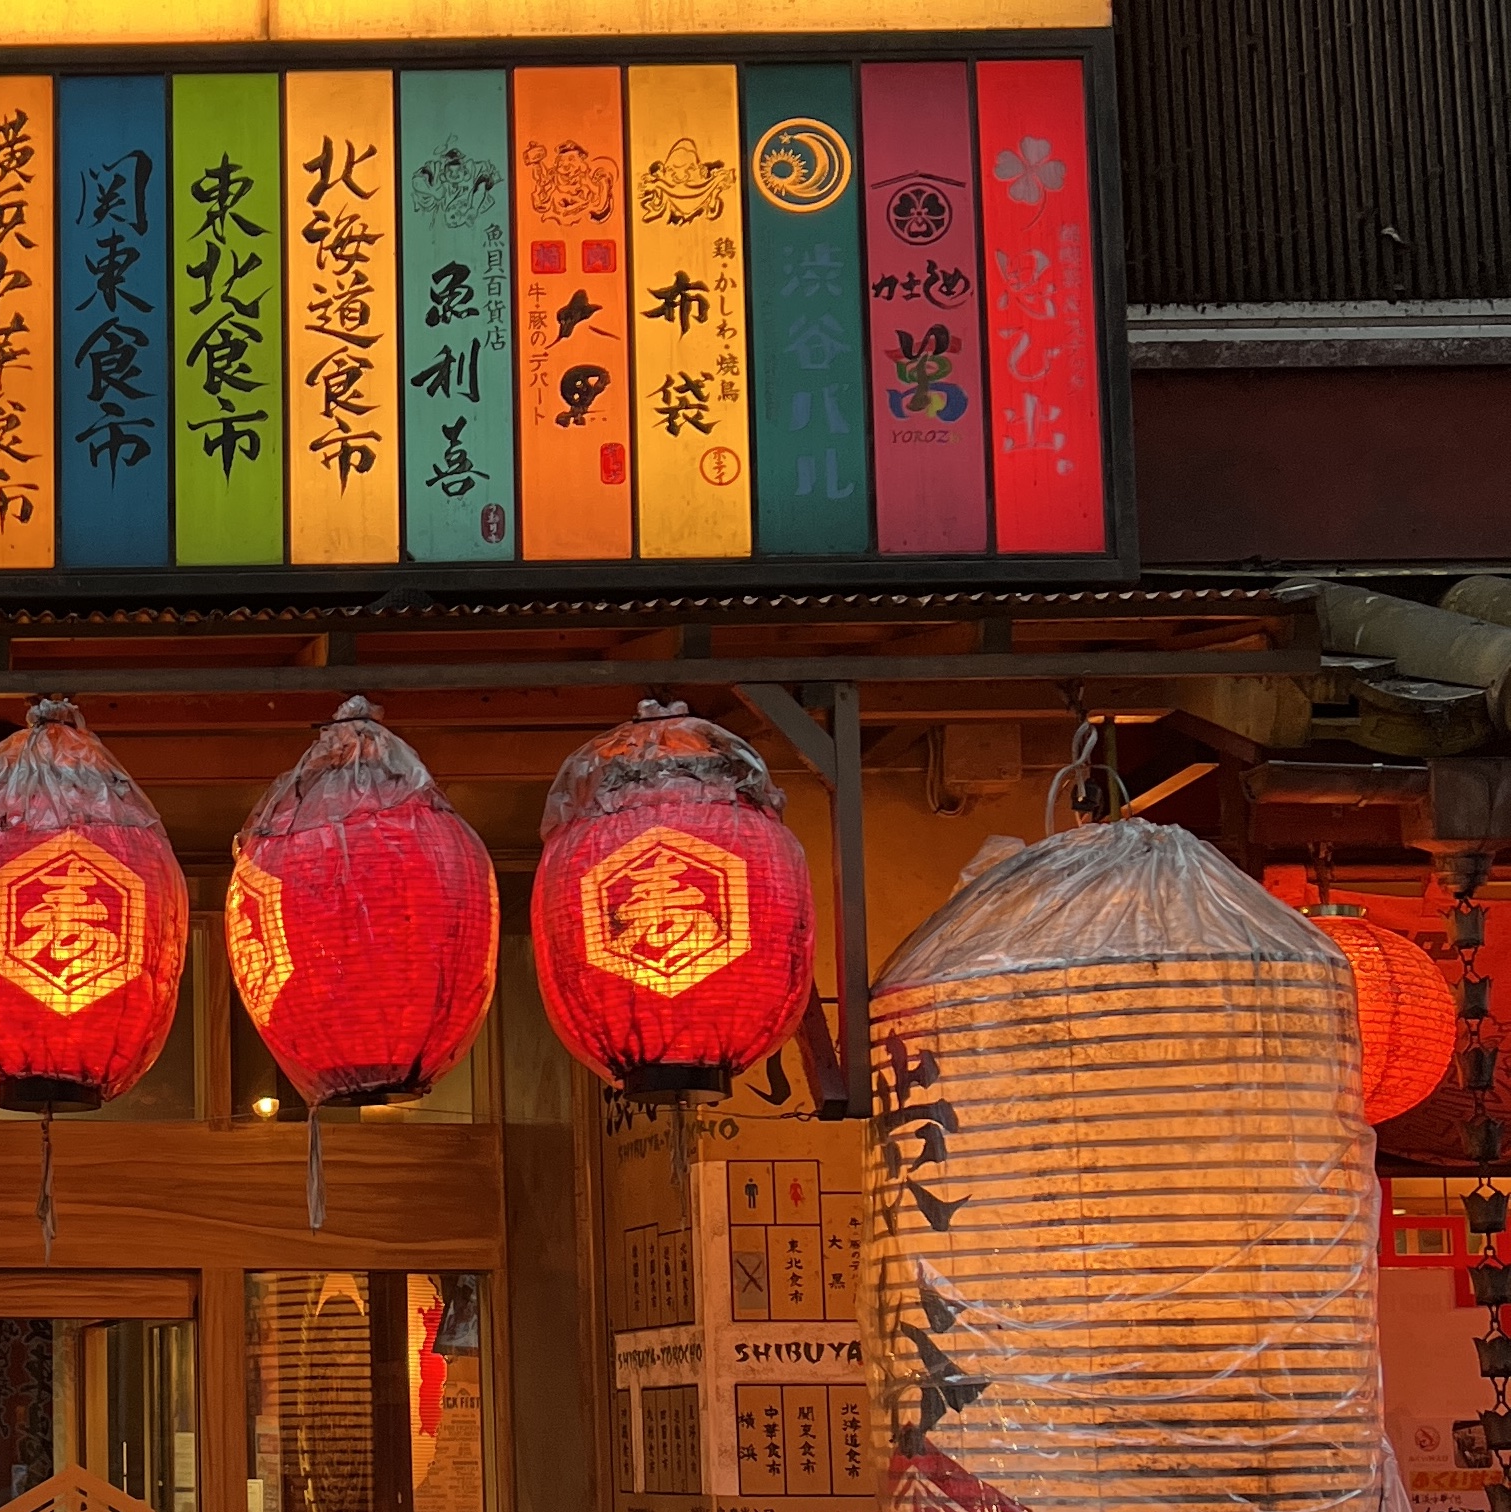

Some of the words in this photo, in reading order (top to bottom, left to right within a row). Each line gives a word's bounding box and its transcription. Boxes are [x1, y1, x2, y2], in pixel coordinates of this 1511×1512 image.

[74, 149, 156, 490] 関東食市
[187, 151, 273, 490] 東北食市
[302, 135, 385, 498] 北海道食市
[482, 222, 507, 352] 魚貝百貨店
[641, 270, 720, 437] 布袋
[781, 242, 855, 500] 渋谷バル
[786, 1240, 803, 1304] 東北食市
[828, 1235, 845, 1289] 大黒
[738, 1411, 757, 1462] 横浜
[763, 1405, 781, 1475] 中華食市
[798, 1406, 816, 1474] 関東食市
[841, 1404, 861, 1478] 北海道食市
